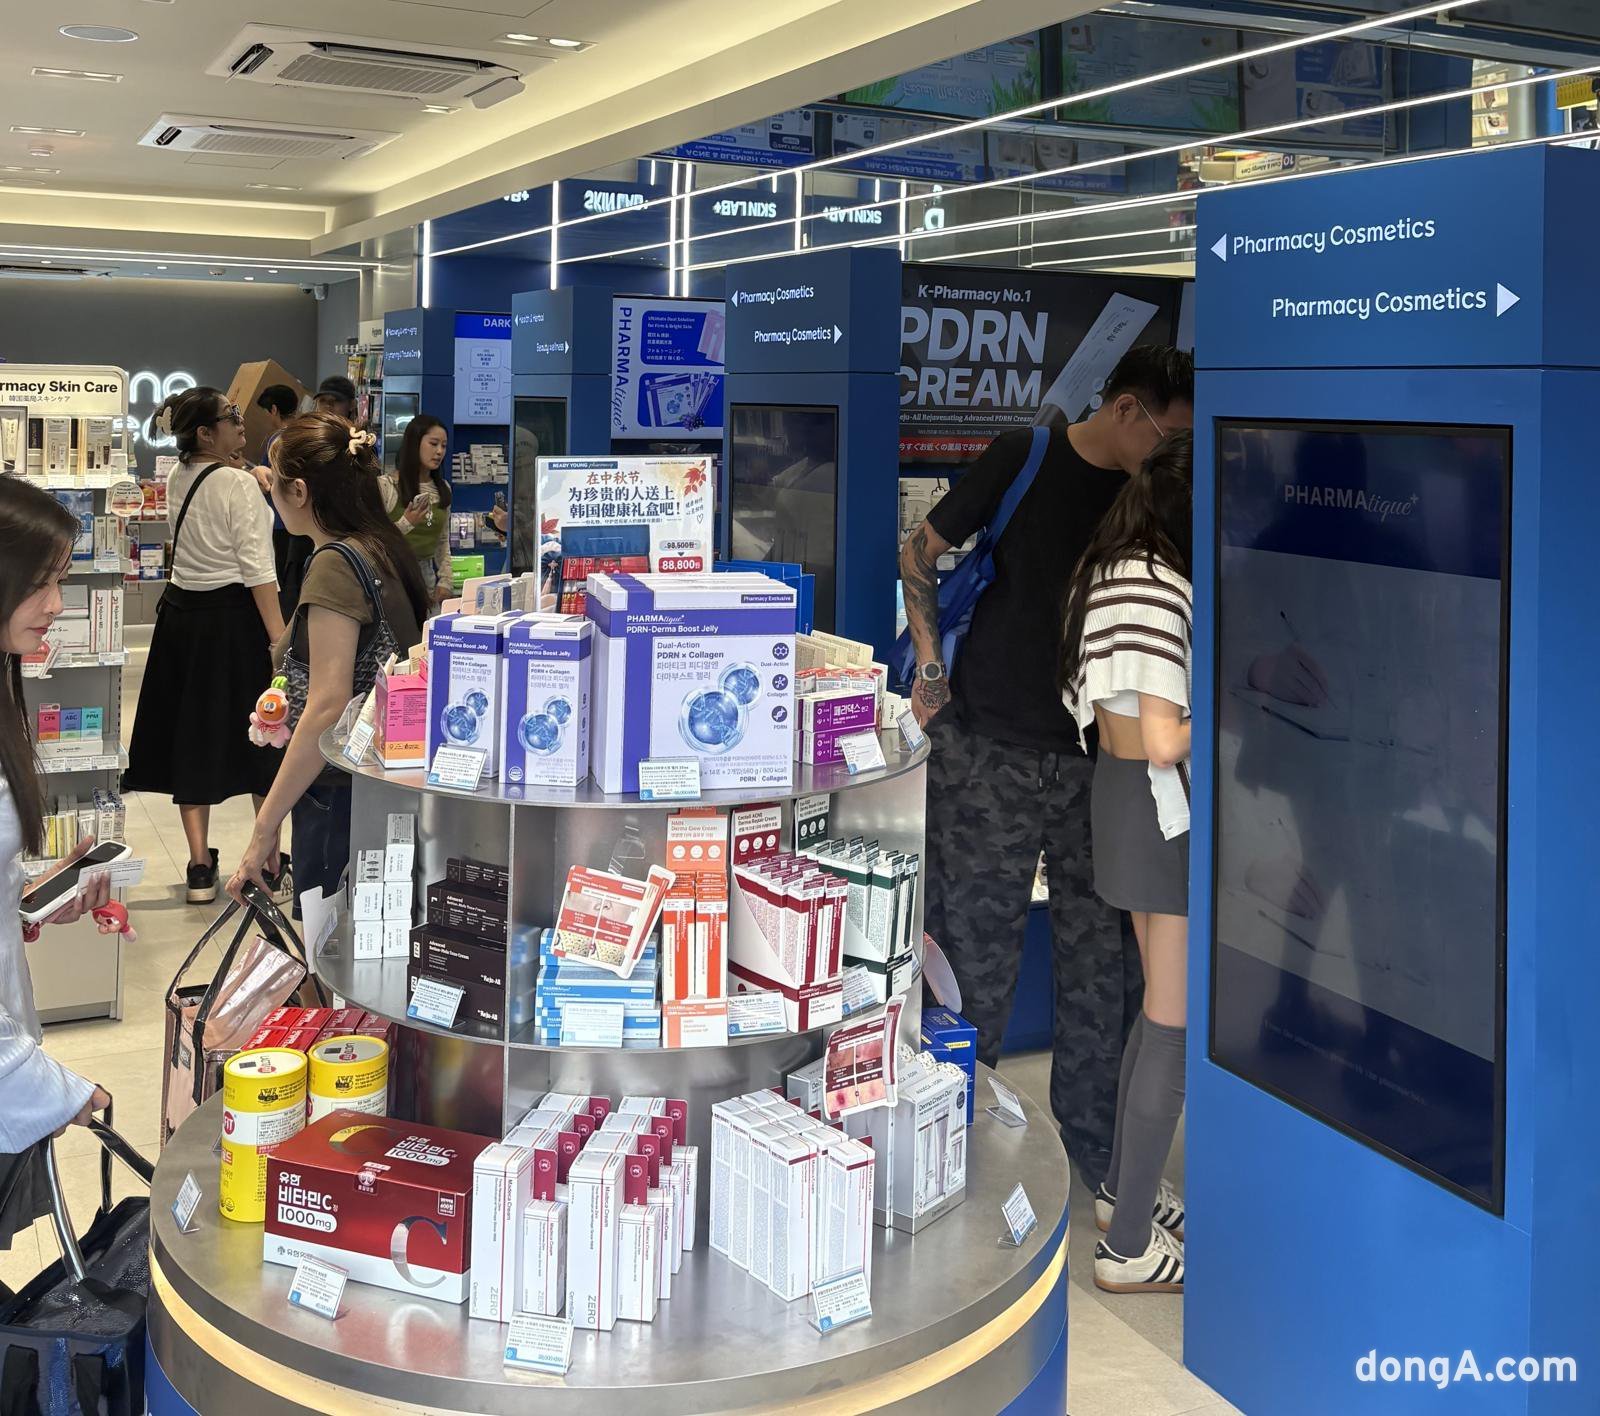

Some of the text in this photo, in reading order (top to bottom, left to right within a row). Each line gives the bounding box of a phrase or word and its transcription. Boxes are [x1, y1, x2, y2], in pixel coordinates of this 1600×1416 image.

[749, 201, 777, 218] SKIN
[855, 209, 882, 225] SKIN
[1233, 217, 1435, 255] Pharmacy Cosmetics
[739, 285, 814, 306] Pharmacy Cosmetics
[918, 284, 1031, 304] K-Pharmacy No.1
[1272, 287, 1487, 320] Pharmacy Cosmetics
[483, 318, 511, 328] DARK
[754, 326, 831, 345] Pharmacy Cosmetics
[900, 306, 1049, 364] PDRN
[49, 380, 81, 393] Skin
[84, 382, 118, 393] Care
[900, 366, 1043, 408] CREAM
[568, 485, 675, 502] 为珍贵的人送上
[743, 595, 766, 603] Pharmacy
[626, 624, 719, 634] PDRN-Derma Boost Jelly
[657, 641, 700, 649] Dual-Action
[657, 651, 724, 660] PDRN Collagen
[657, 661, 719, 670] 파마티크 피디알엔
[656, 671, 711, 681] 더마부스트 젤리
[390, 1148, 443, 1165] 1000mg
[279, 1171, 301, 1185] 유한
[280, 1205, 332, 1231] 1000mg
[490, 1286, 499, 1316] ZERO
[587, 1295, 596, 1324] ZERO
